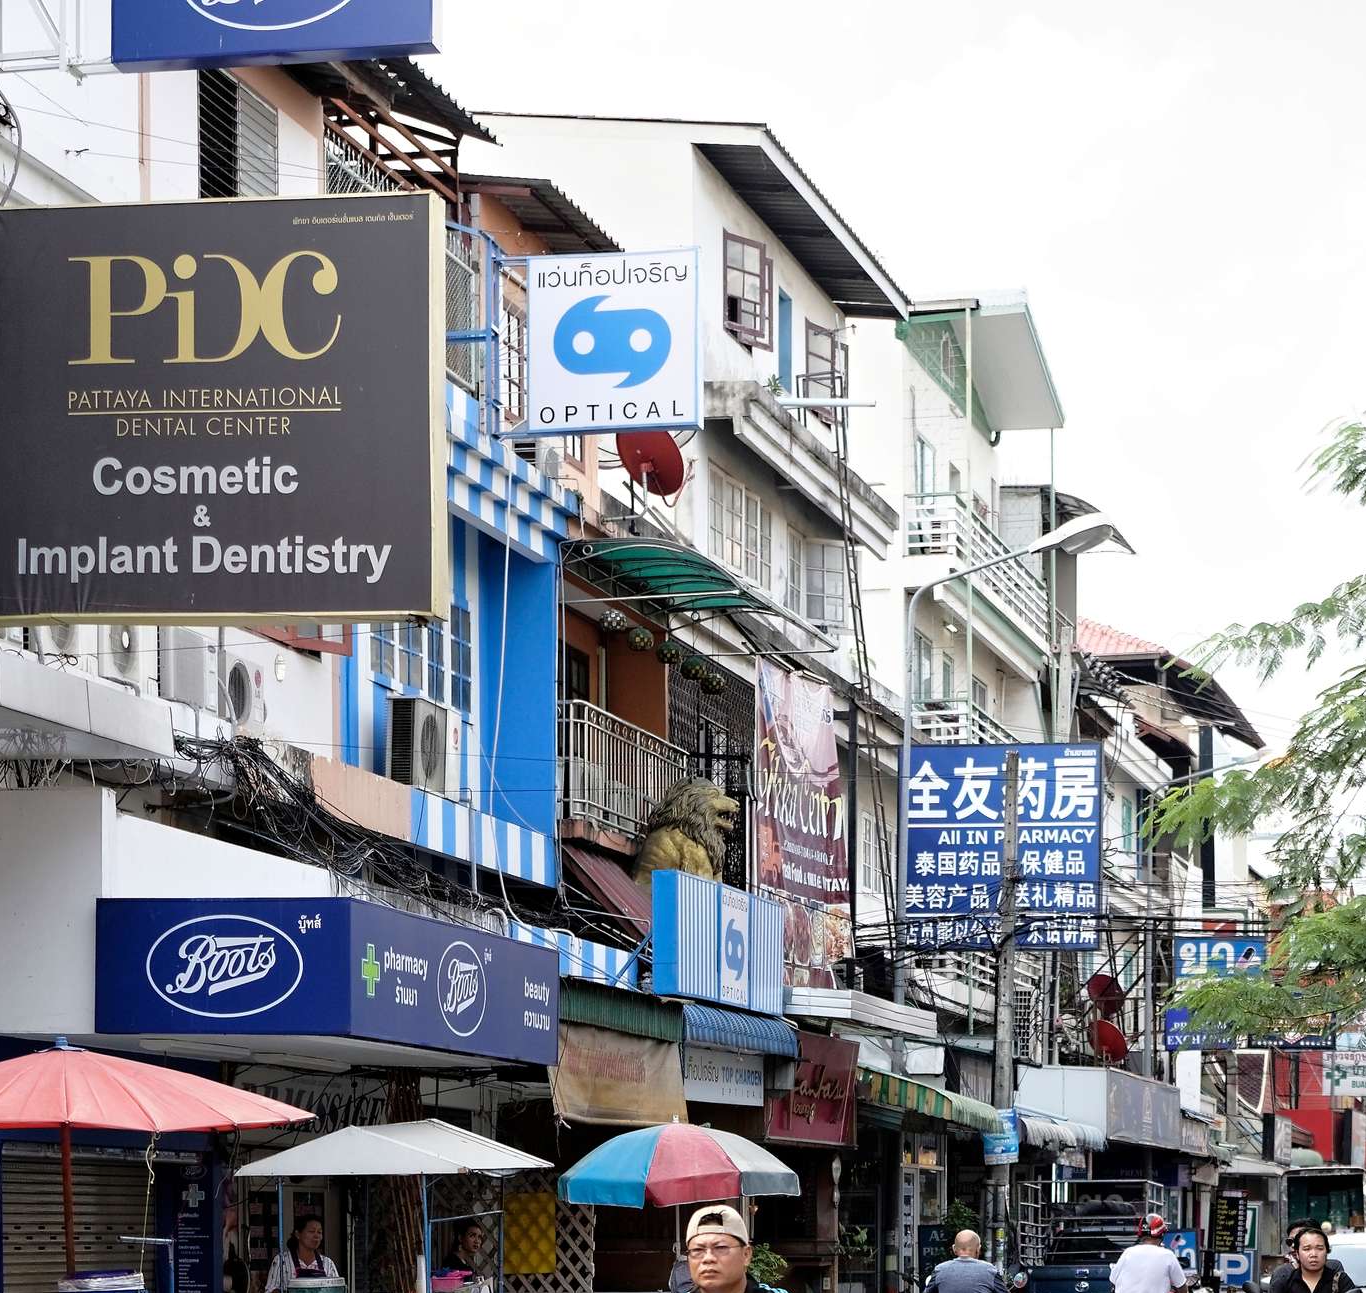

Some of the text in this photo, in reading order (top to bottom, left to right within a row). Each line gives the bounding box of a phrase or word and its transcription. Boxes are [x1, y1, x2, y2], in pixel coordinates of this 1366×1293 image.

[538, 259, 687, 288] แว่นท็อปเจริญ
[68, 386, 341, 409] PATTAYA INTERNATIONAL
[540, 400, 684, 424] OPTICAL
[116, 416, 291, 437] DENTAL CENTER
[93, 456, 299, 496] Cosmetic
[193, 504, 211, 527] &
[18, 535, 392, 584] Implant Dentistry
[908, 757, 1098, 820] 全友药房
[966, 830, 988, 845] IN
[994, 829, 1096, 845] PARMACY
[915, 850, 1085, 877] 泰国药品 保健品
[905, 884, 989, 909] 美容产品
[165, 934, 276, 996] Boots
[384, 946, 429, 982] pharmacy
[395, 982, 419, 1007] ร้านยา
[443, 958, 479, 1016] Boots
[524, 976, 550, 1006] beauty
[1220, 1254, 1249, 1284] P
